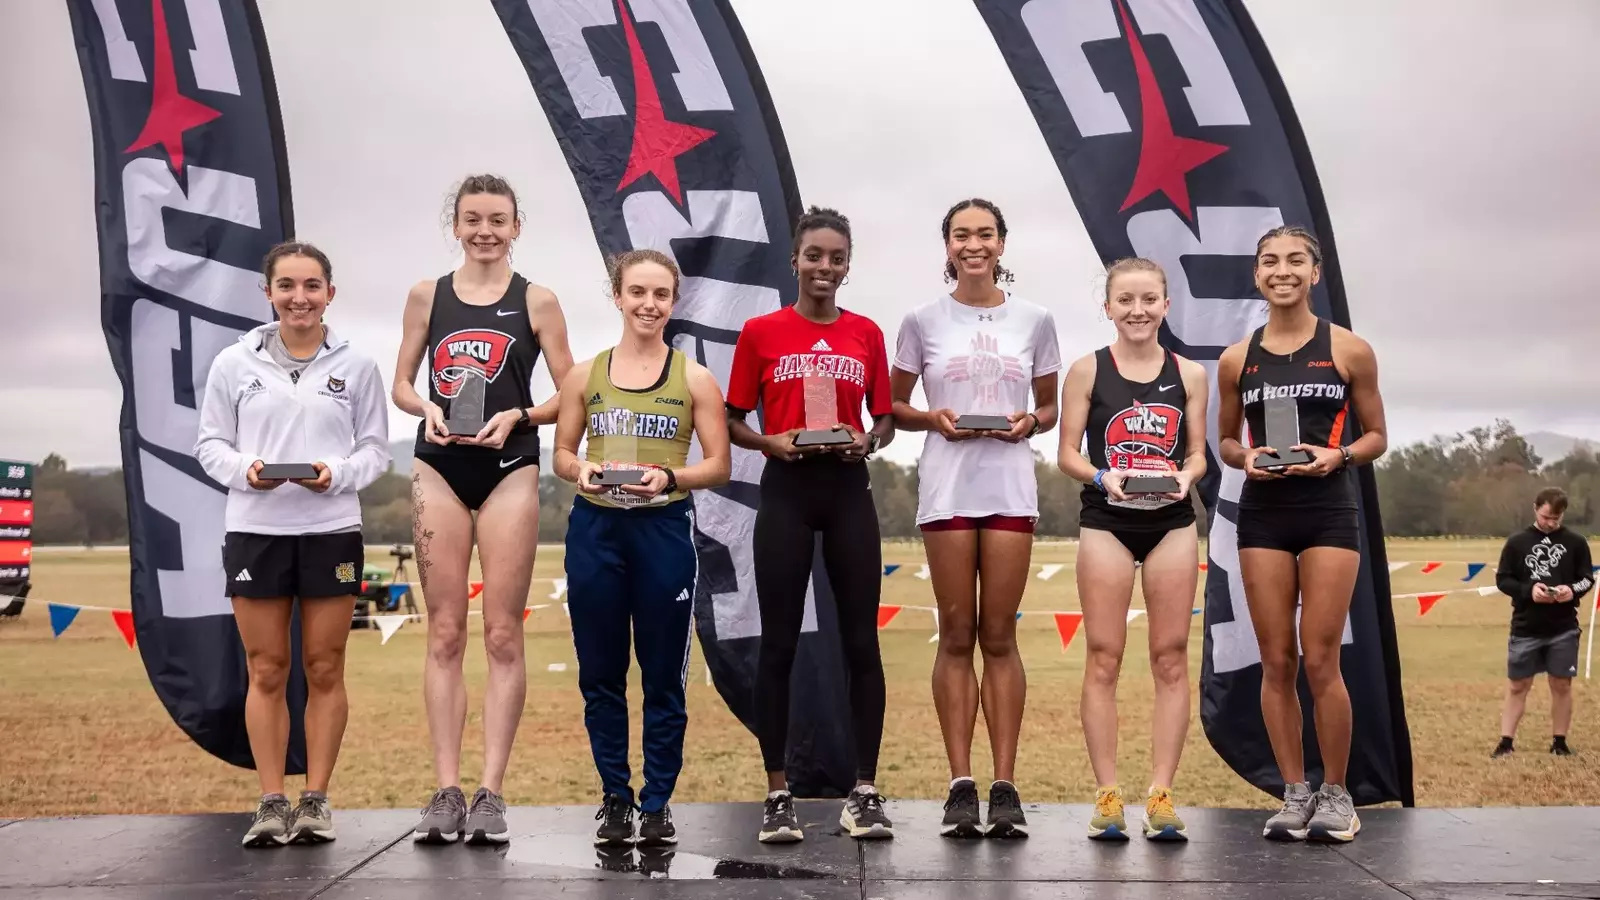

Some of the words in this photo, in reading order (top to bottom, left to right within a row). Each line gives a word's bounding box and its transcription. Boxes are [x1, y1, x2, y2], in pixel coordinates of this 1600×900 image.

[447, 340, 493, 362] WKU
[773, 353, 816, 378] JAX
[773, 372, 811, 384] CROSS
[818, 372, 864, 388] COUNTRY
[1263, 383, 1346, 400] HOUSTON
[591, 407, 679, 440] PANTHERS
